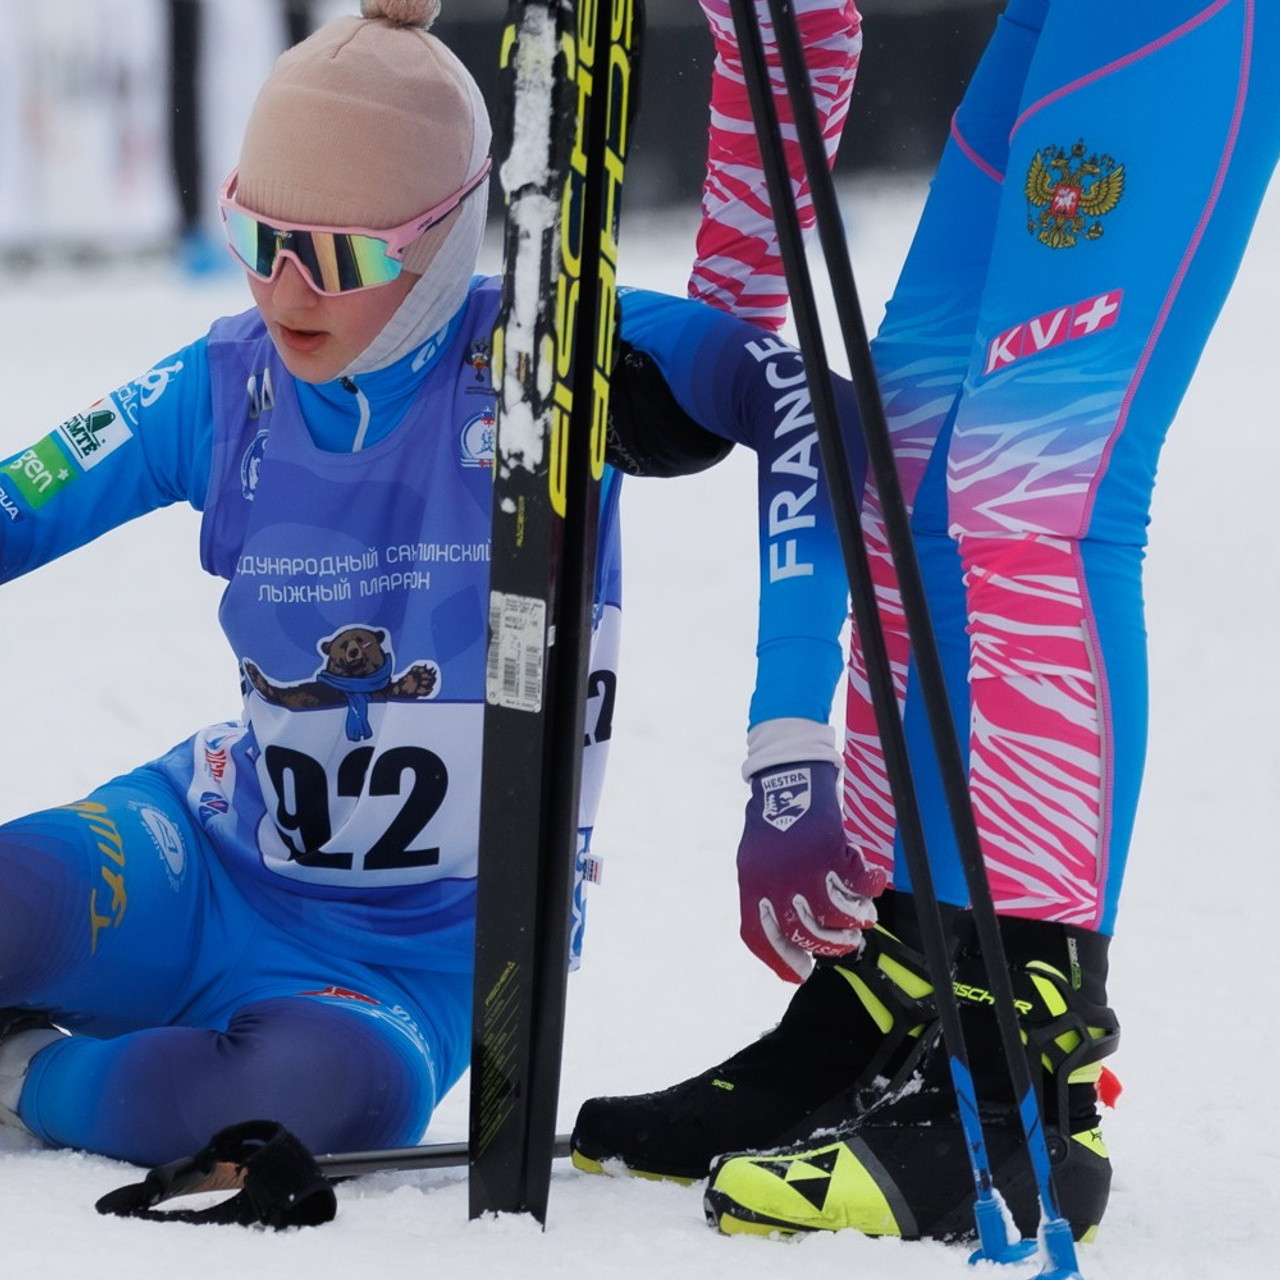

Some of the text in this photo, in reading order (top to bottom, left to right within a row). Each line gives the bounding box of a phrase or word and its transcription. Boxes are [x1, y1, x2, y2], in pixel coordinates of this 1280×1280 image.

[985, 293, 1120, 376] KV+
[745, 334, 815, 584] FRANCE
[236, 546, 379, 577] ДУНАРОДНЫЙ
[258, 578, 352, 603] ЛЫЖНЫЙ
[763, 773, 808, 791] HESTRA
[952, 981, 1033, 1015] ISCHR
